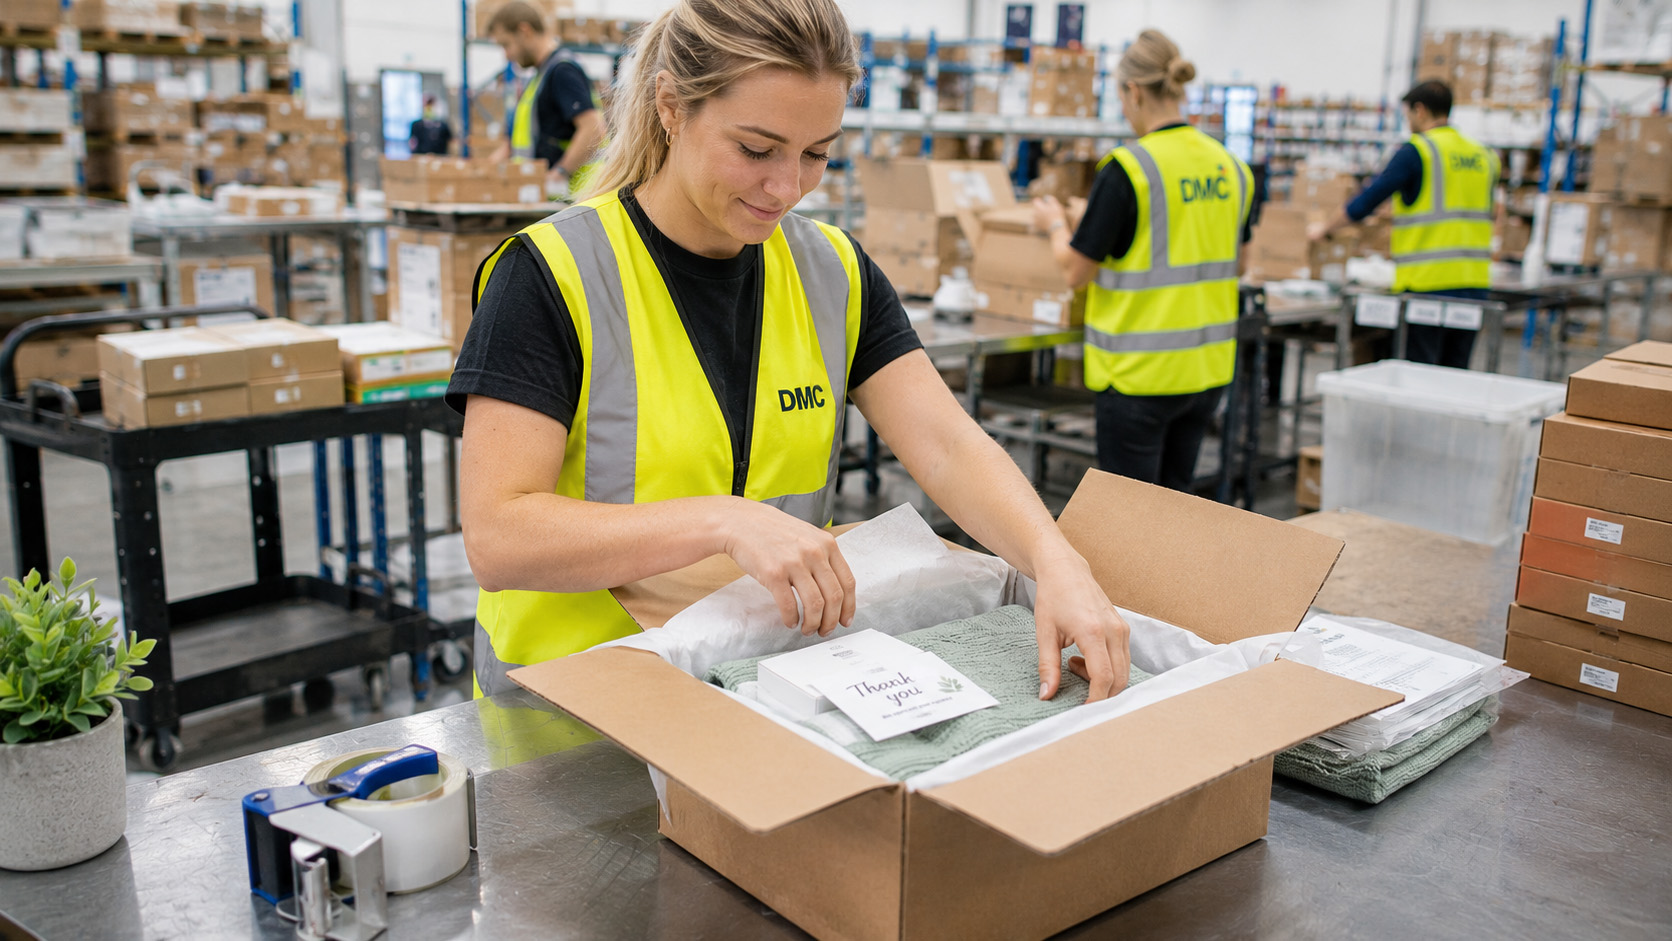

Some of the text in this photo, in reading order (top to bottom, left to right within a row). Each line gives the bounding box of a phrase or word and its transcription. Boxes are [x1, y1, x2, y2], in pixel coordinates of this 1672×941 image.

[1180, 176, 1230, 203] DMC
[778, 384, 825, 412] DMC
[846, 672, 916, 698] Thank
[886, 686, 923, 707] you
